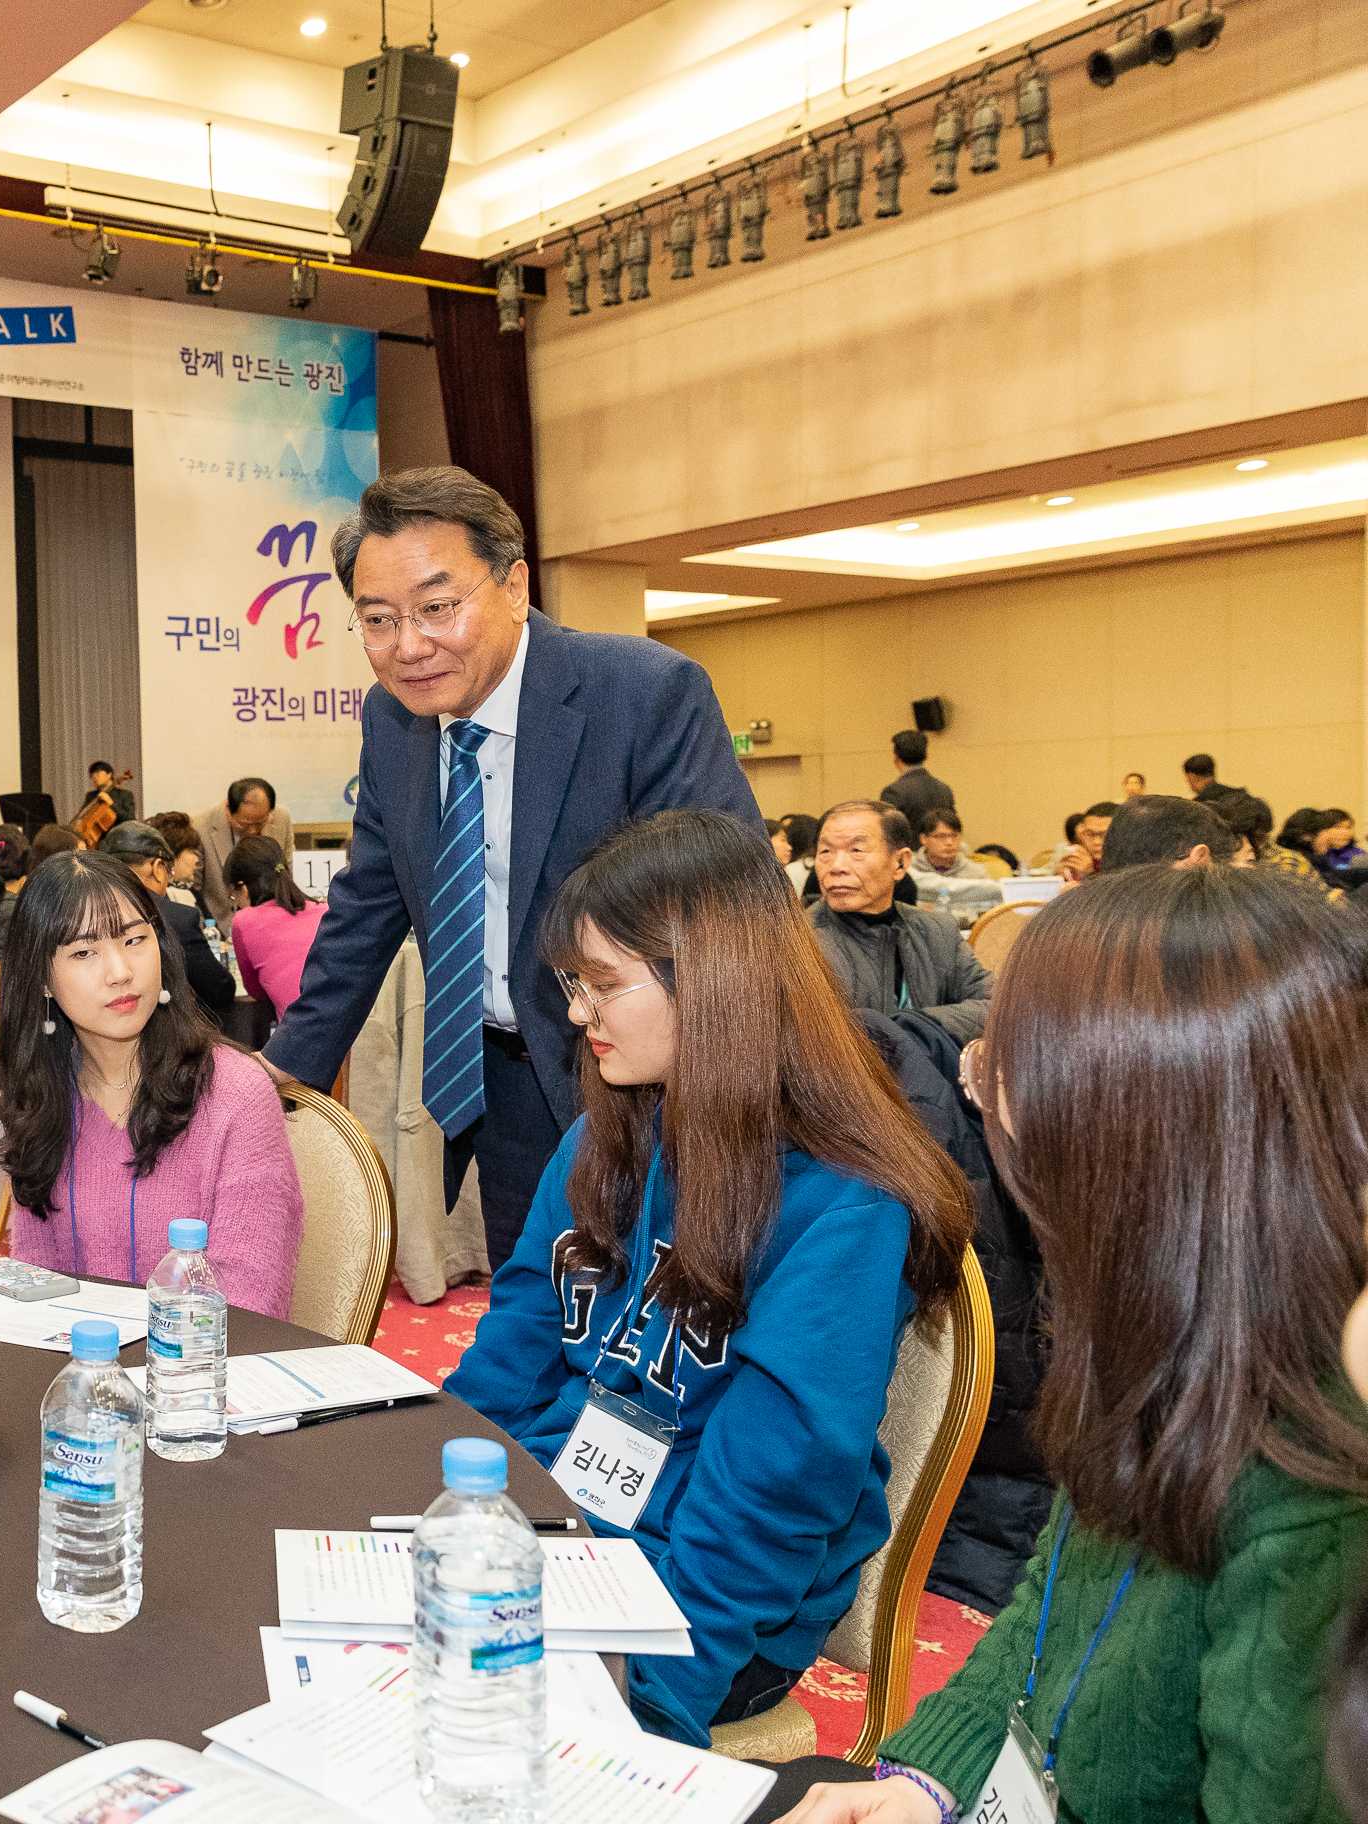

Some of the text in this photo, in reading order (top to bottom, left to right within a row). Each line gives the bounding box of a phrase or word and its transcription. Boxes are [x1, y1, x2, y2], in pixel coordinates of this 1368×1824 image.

[179, 346, 345, 394] 함께 만드는 광진
[164, 614, 241, 652] 구민의
[232, 686, 362, 722] 광진의 미래
[304, 860, 332, 888] 11
[55, 1443, 103, 1465] Sansu
[572, 1439, 646, 1498] 김나경
